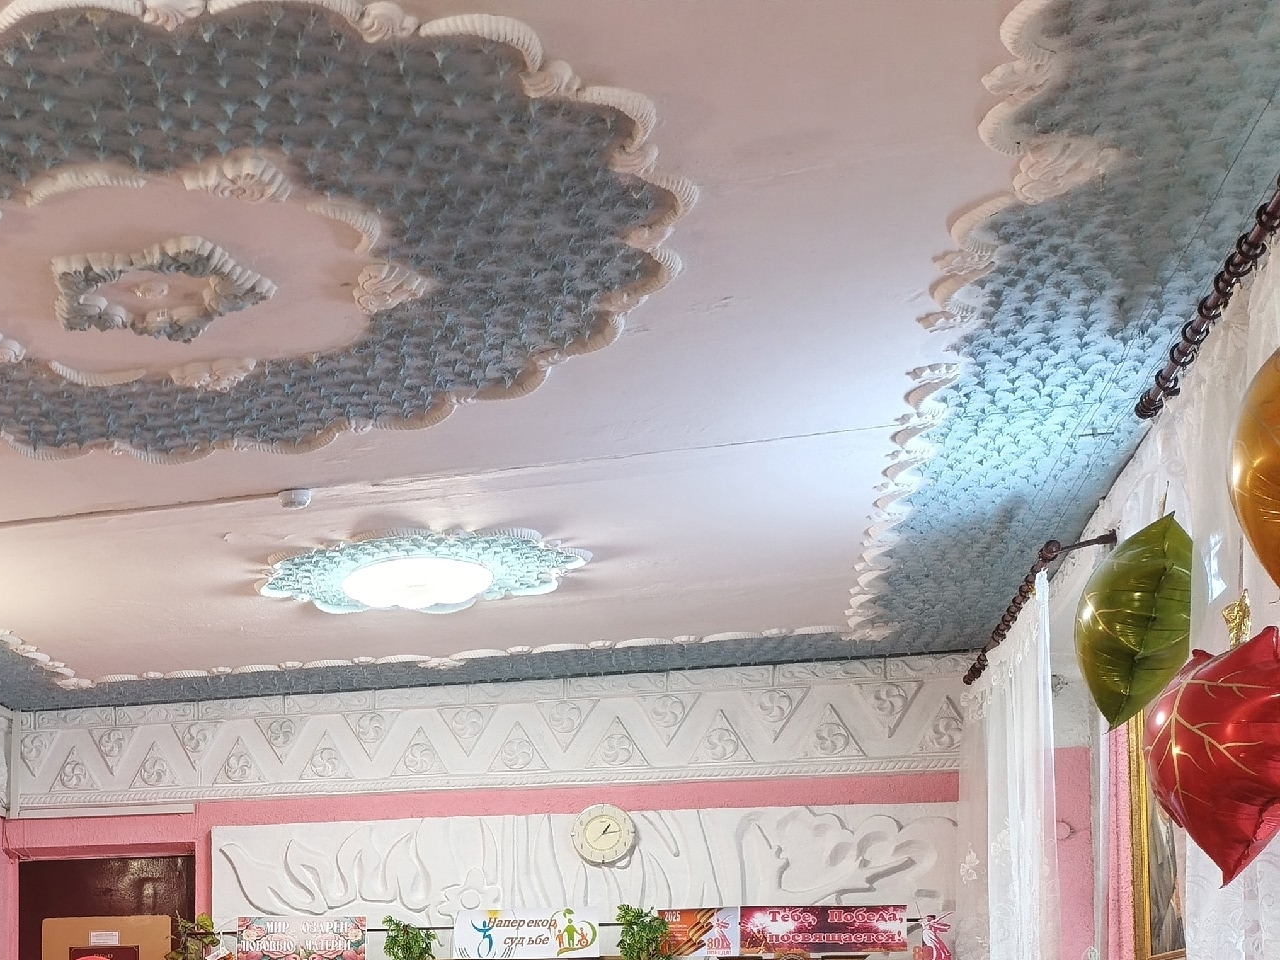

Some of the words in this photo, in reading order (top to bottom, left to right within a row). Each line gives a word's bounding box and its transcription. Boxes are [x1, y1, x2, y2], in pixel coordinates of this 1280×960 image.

[664, 911, 680, 922] 2025
[769, 909, 817, 925] Тебе,
[828, 909, 903, 924] Победа,
[266, 921, 290, 934] МИР
[768, 930, 903, 944] посвящается!
[239, 939, 294, 952] ЛЮБОВЬЮ
